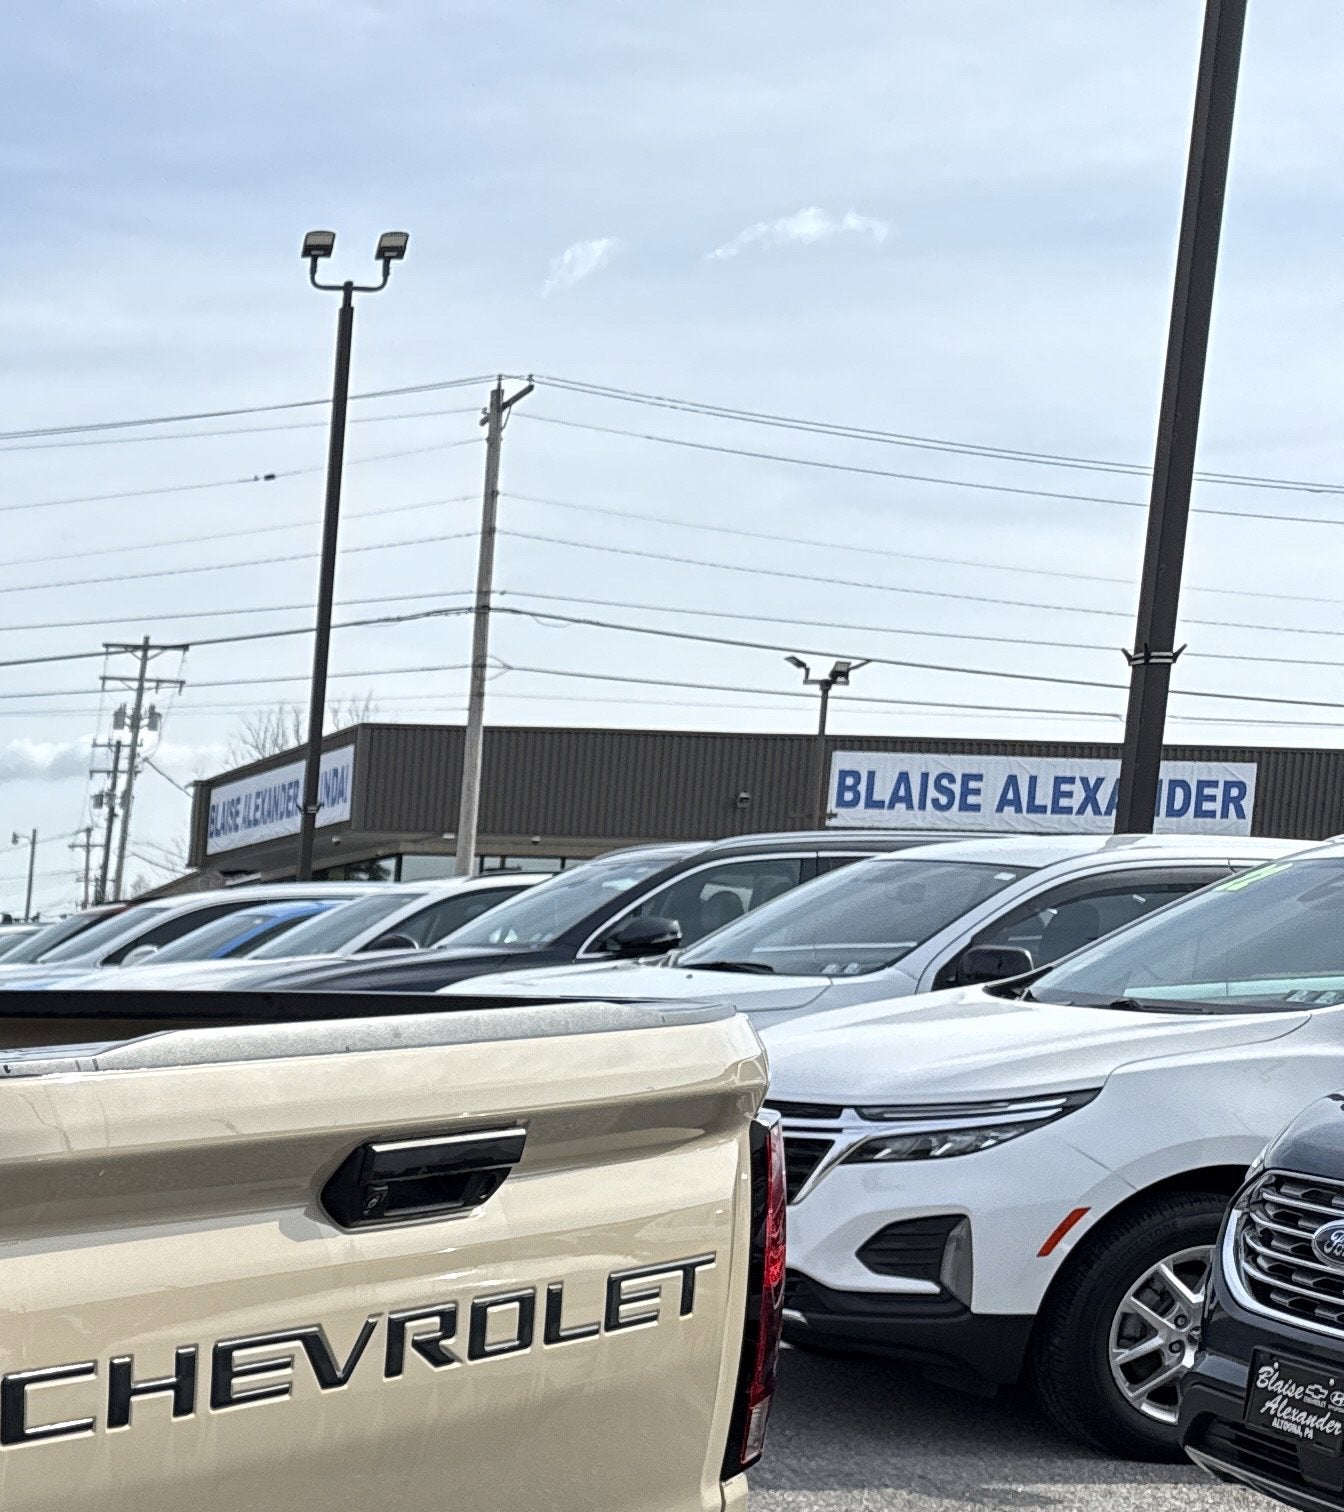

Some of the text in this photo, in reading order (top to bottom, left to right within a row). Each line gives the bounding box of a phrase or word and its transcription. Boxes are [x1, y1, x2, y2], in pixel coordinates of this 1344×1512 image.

[209, 796, 241, 838] BLAISE
[242, 779, 299, 830] ALEXANDER
[834, 769, 1248, 820] BLAISE ALEXDER
[1256, 1365, 1305, 1400] Blaise
[1259, 1394, 1343, 1435] Alexander
